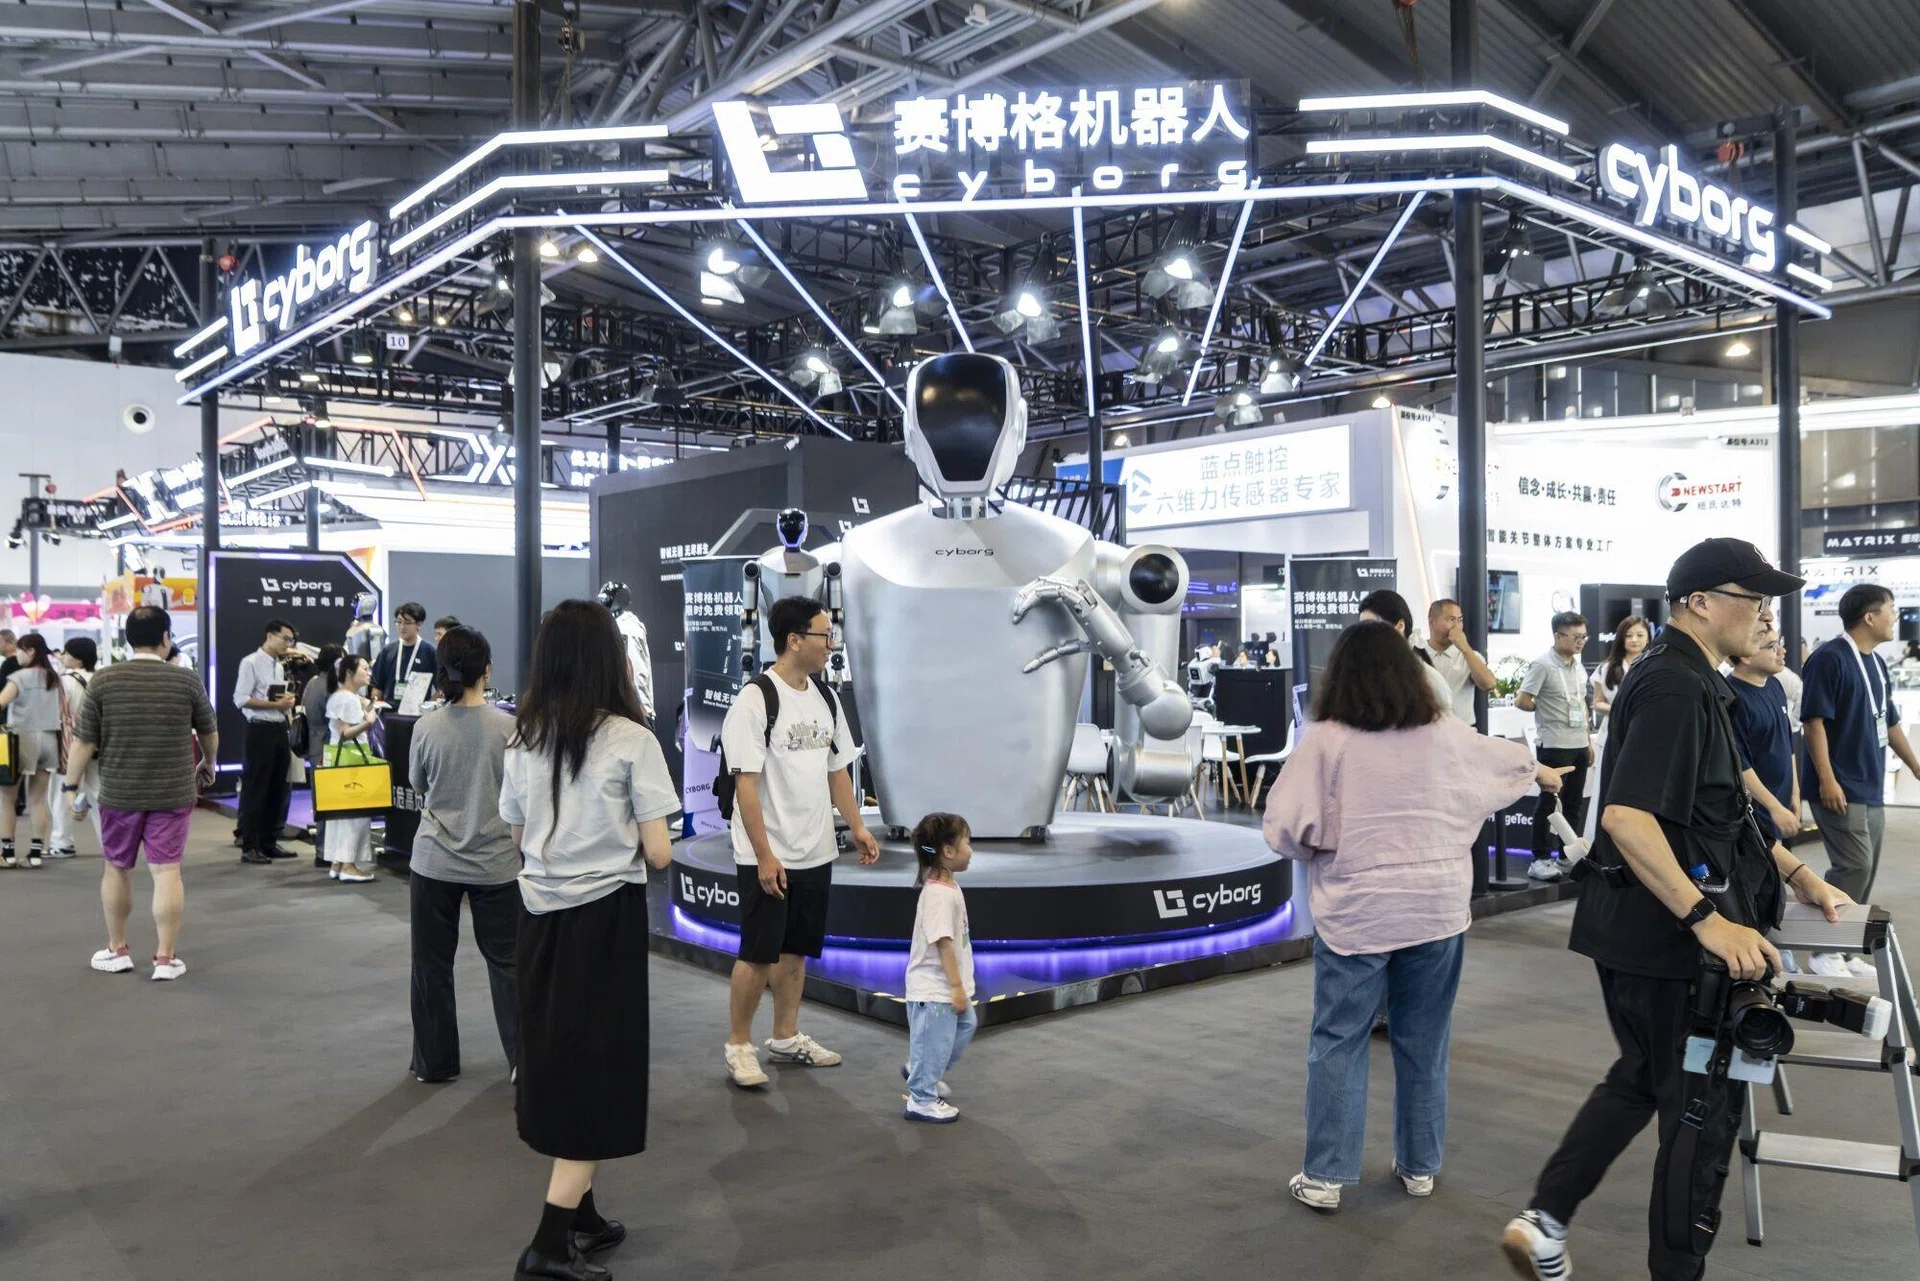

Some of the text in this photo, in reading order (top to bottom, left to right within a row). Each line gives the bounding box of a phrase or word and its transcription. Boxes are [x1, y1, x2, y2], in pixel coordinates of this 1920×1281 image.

[892, 83, 1249, 155] 赛博格机器人
[893, 159, 1249, 200] cyborg
[1602, 142, 1776, 272] cyborg
[263, 220, 375, 331] cyborg
[390, 336, 406, 348] 10
[1199, 445, 1289, 481] 蓝点触控
[1156, 470, 1341, 516] 六维力传感器专家
[1683, 481, 1742, 497] NEWSTART
[1826, 534, 1896, 548] MATRIX
[935, 547, 994, 557] cyborg
[282, 578, 333, 592] cyborg
[684, 591, 743, 604] 赛博格机器人
[1294, 602, 1360, 615] 限时免费领取
[684, 783, 711, 794] CYBORG
[696, 881, 740, 907] cybo
[1191, 881, 1263, 914] cyborg
